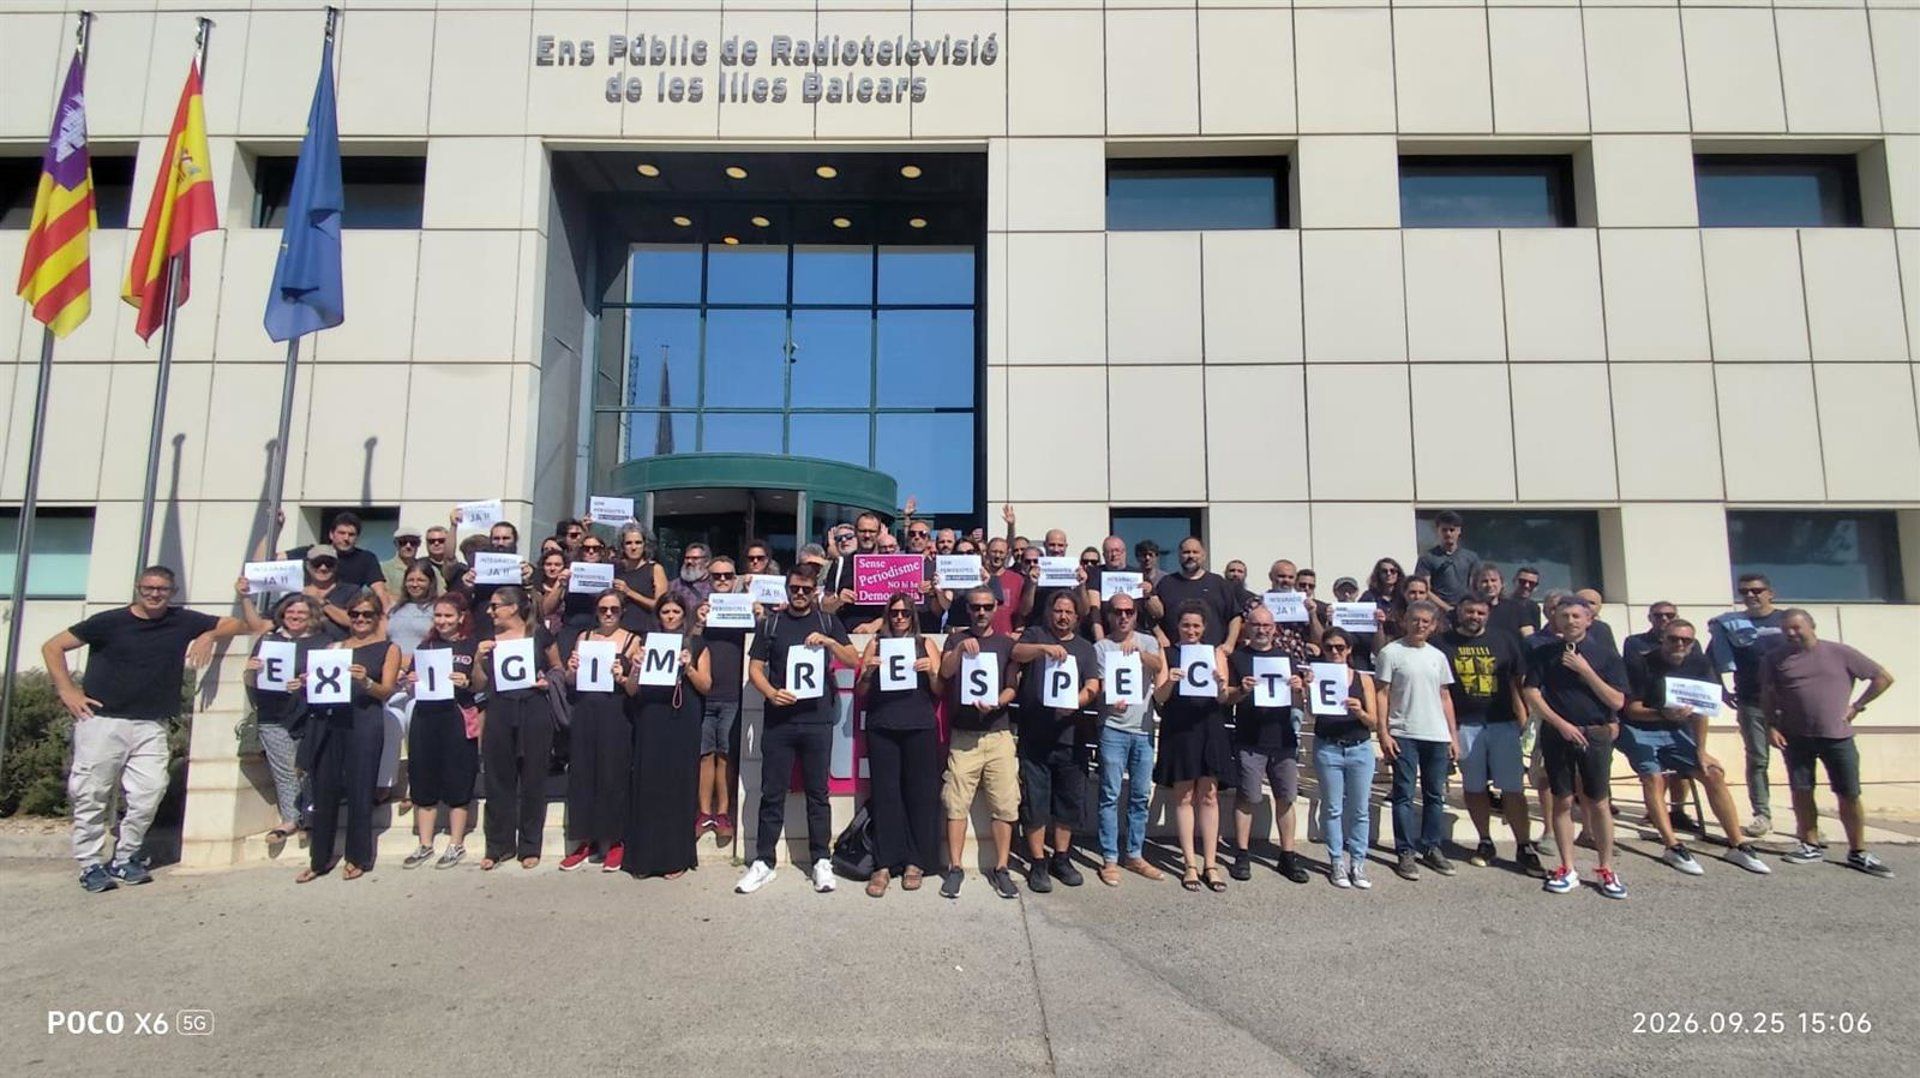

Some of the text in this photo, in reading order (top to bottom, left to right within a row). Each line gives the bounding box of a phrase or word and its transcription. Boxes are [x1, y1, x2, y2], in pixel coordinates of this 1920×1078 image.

[536, 32, 999, 66] Ens Públic de Radiotelevisió
[605, 72, 927, 104] de les Illes Balears
[858, 557, 886, 569] Sense
[858, 561, 920, 587] Periodisme
[267, 658, 283, 682] E
[501, 655, 526, 681] G
[591, 657, 598, 682] I
[646, 648, 675, 673] M
[890, 655, 906, 681] E
[315, 666, 341, 694] X
[428, 666, 435, 692] I
[794, 662, 816, 690] R
[969, 669, 988, 696] S
[1052, 671, 1071, 698] P
[1115, 668, 1133, 695] E
[1187, 661, 1209, 687] C
[1260, 673, 1283, 698] T
[1320, 680, 1337, 706] E
